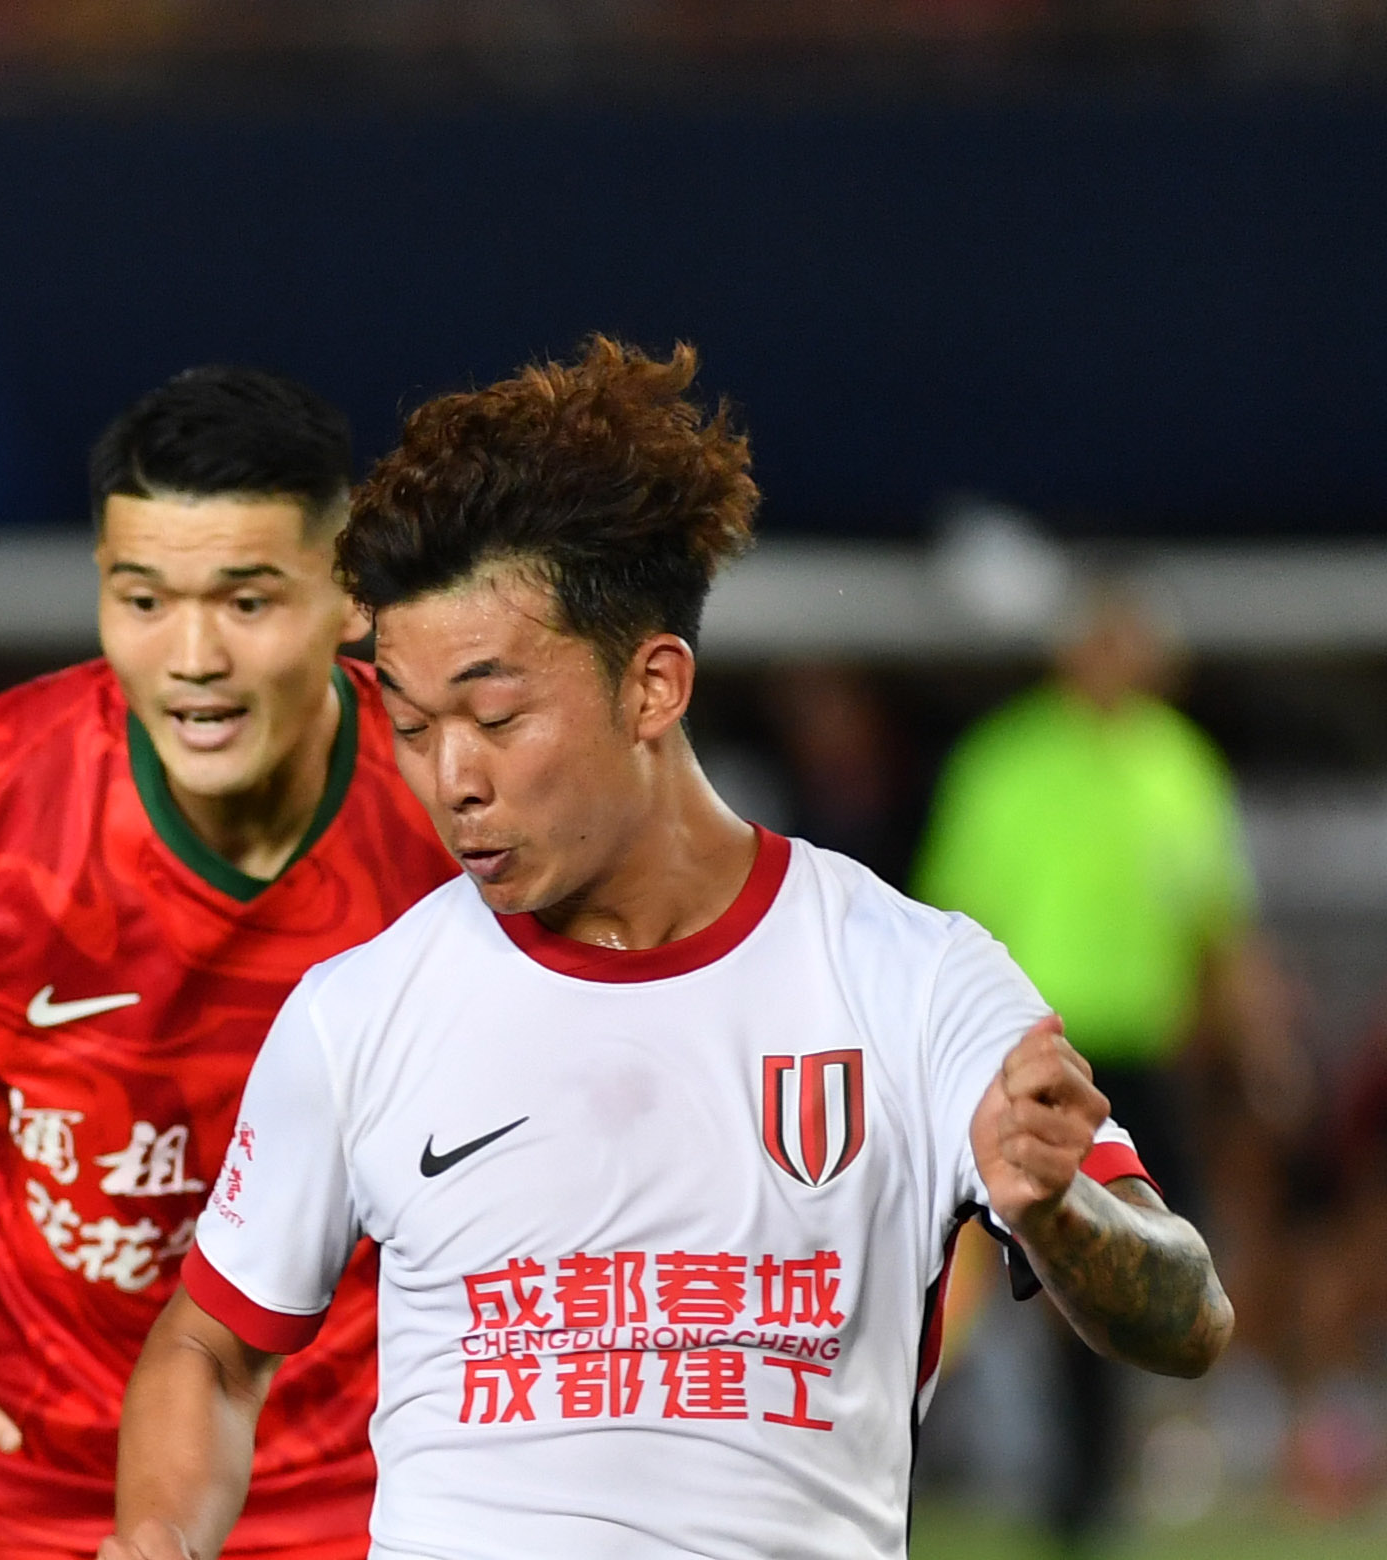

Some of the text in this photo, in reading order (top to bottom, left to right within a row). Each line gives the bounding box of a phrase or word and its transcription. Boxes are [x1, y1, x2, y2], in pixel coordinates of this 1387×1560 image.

[462, 1250, 845, 1331] 成都蓉城
[461, 1326, 841, 1361] CHENGDU RONGCHENG
[458, 1349, 834, 1432] 成都建工
